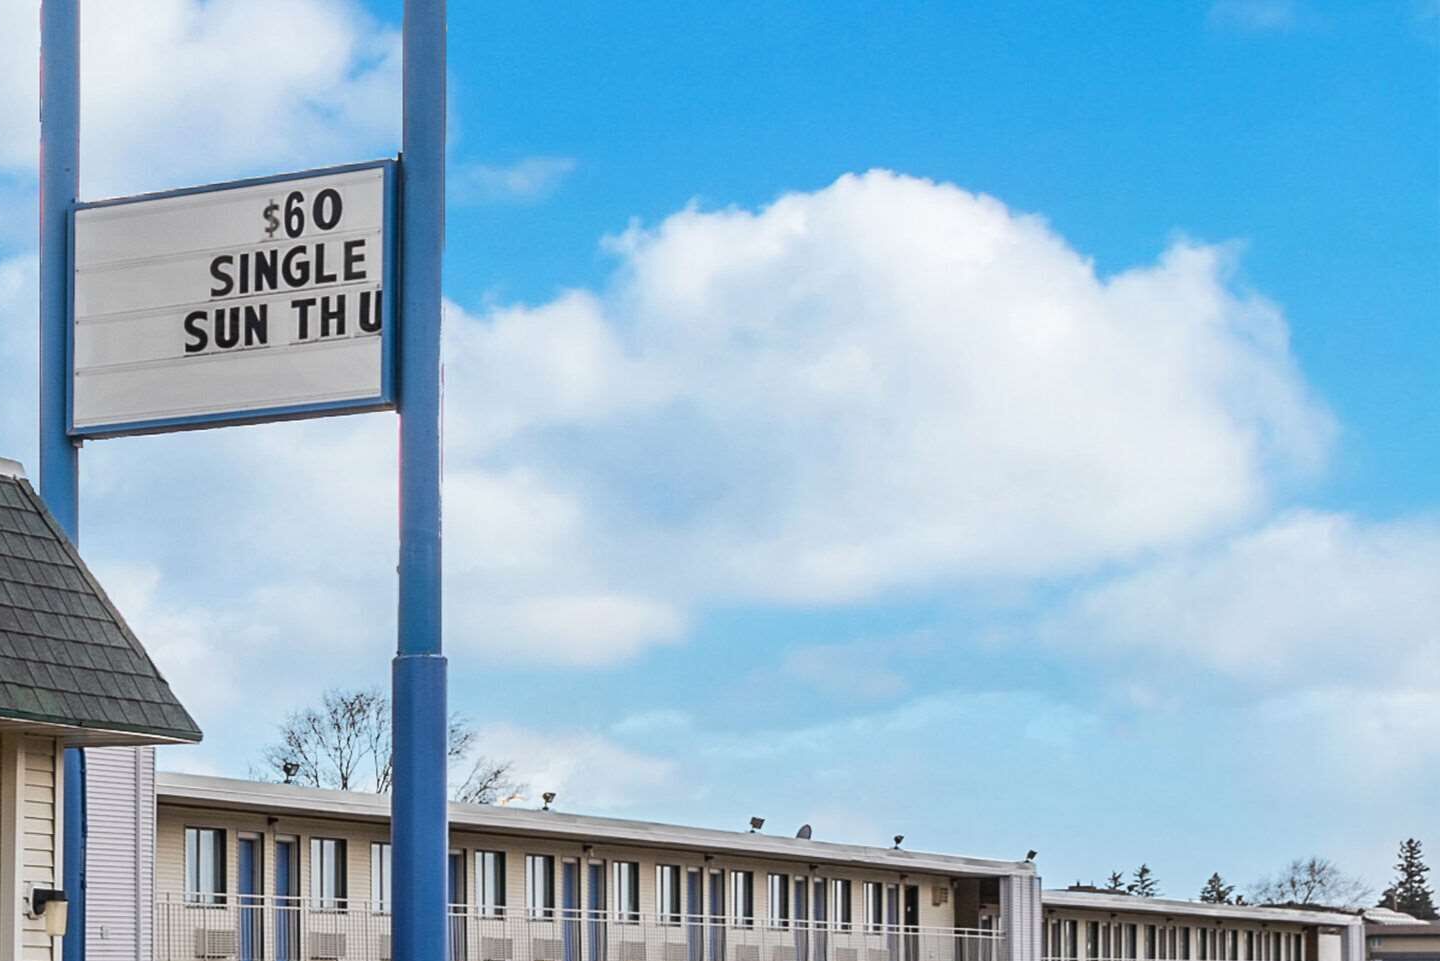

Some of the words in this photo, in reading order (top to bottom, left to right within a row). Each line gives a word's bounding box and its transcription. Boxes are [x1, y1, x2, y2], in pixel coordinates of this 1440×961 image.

[263, 188, 343, 239] $60
[210, 239, 367, 297] SINGLE
[183, 303, 268, 353] SUN
[291, 290, 383, 340] THU
